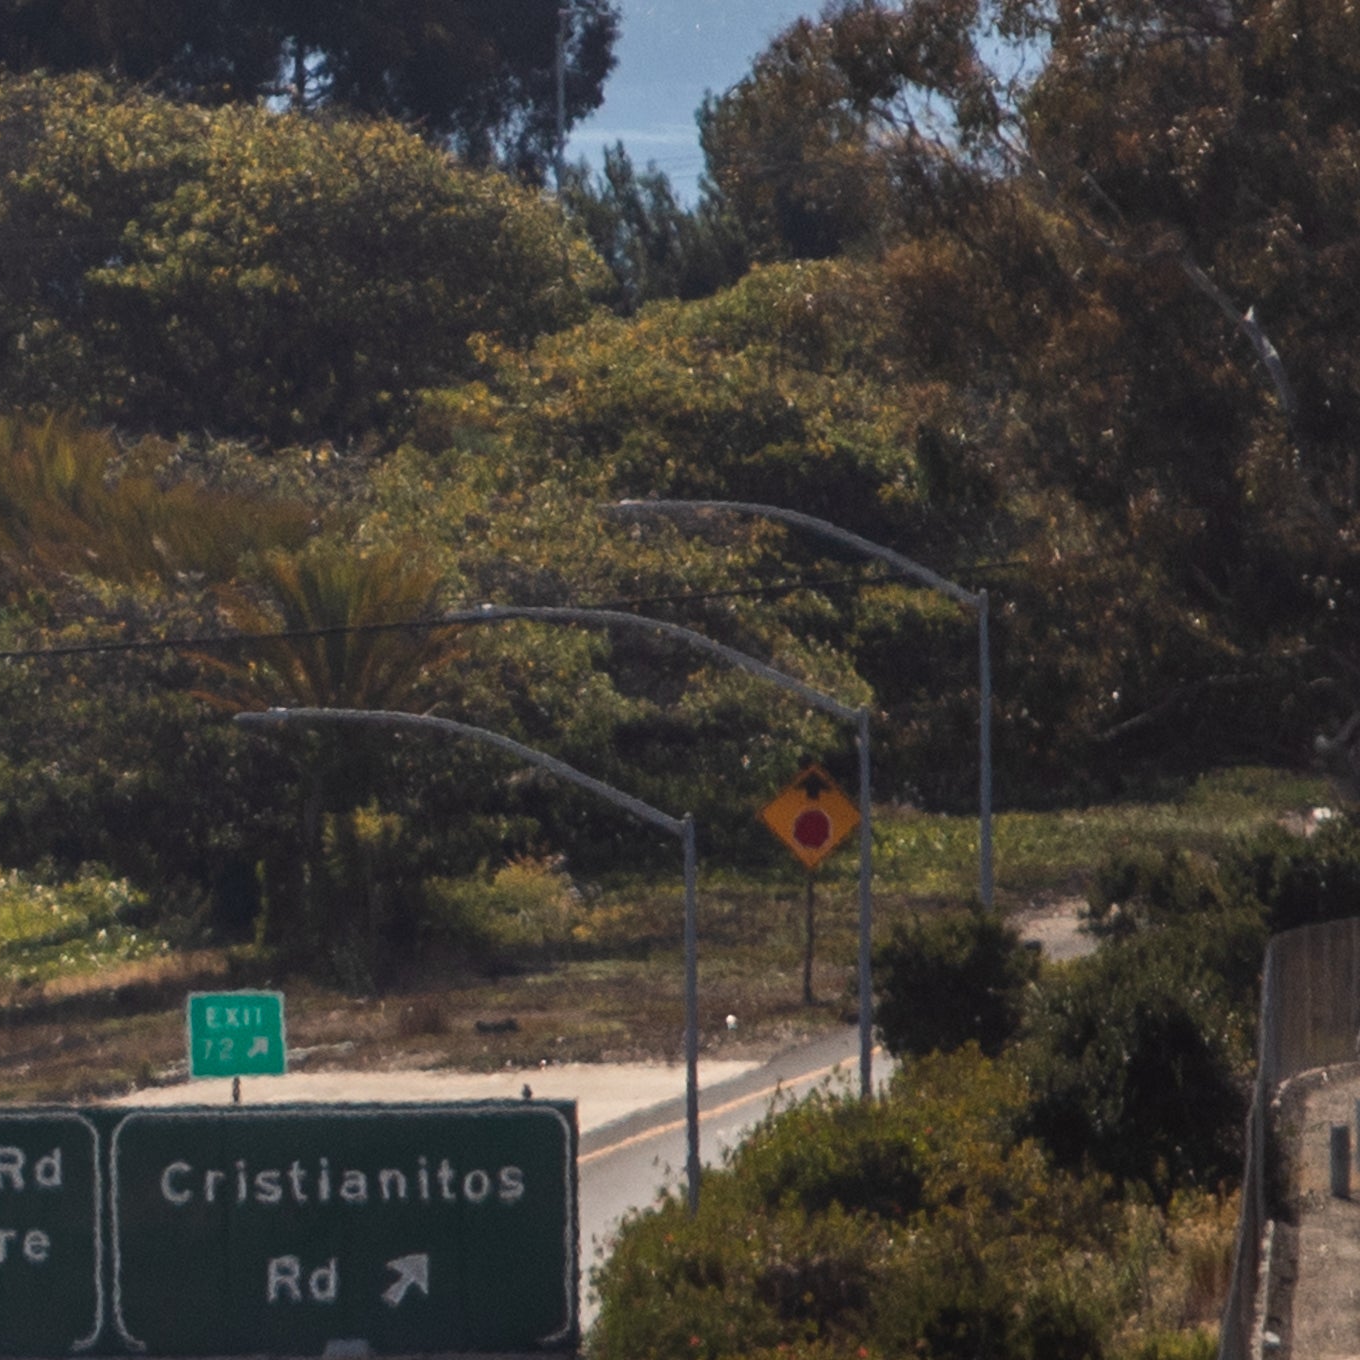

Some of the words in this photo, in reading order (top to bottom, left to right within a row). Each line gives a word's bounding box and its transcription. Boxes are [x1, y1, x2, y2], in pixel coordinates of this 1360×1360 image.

[205, 1005, 262, 1029] EXIT
[201, 1037, 235, 1061] 72
[160, 1155, 526, 1206] Cristianitos
[267, 1254, 339, 1303] Rd
